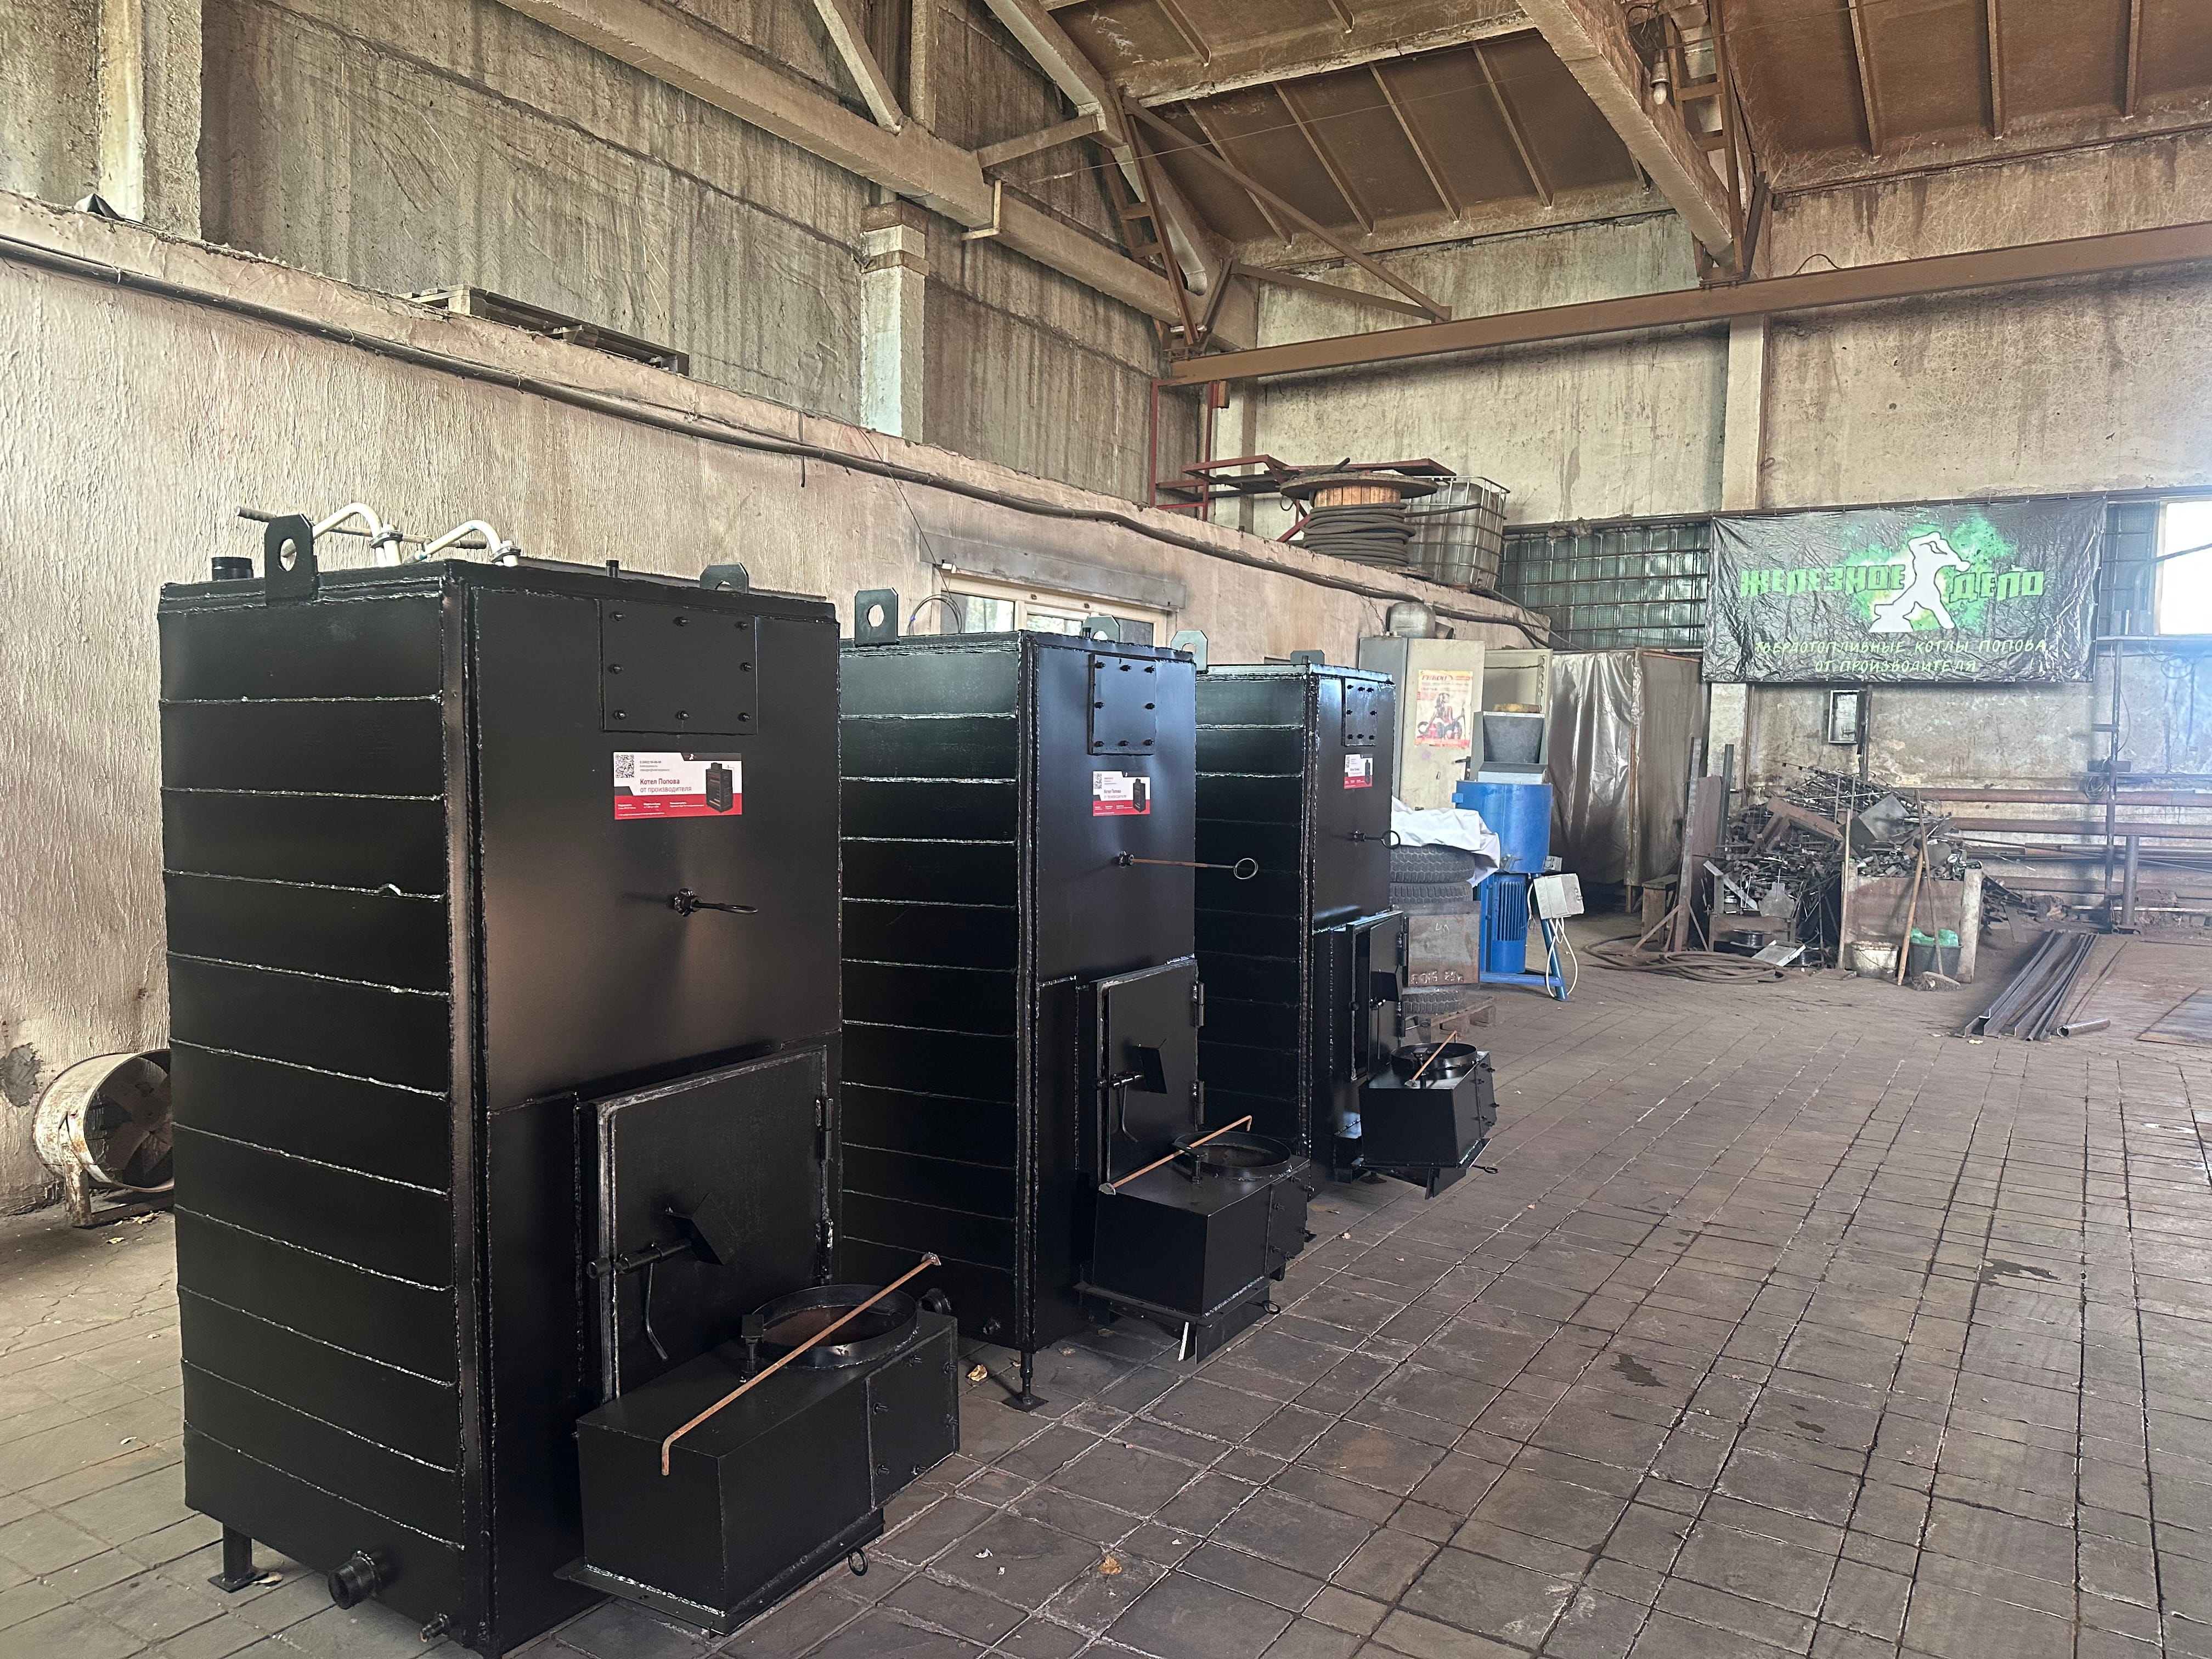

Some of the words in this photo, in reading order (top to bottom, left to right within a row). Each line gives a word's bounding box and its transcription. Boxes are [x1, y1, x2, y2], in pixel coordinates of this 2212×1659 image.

[1740, 564, 1906, 597] ЖЕЛЕЗНОЕ
[1949, 571, 2045, 603] ДЕЛО
[1756, 640, 1906, 656] ТВЕРДОТОПЛИВНЫЕ
[1915, 640, 1969, 654] КОТЛЫ
[1978, 639, 2046, 652] ПОПОВА
[1815, 660, 1833, 673] ОТ
[1839, 659, 1977, 673] ПРОИЗВОДИТЕЛЯ
